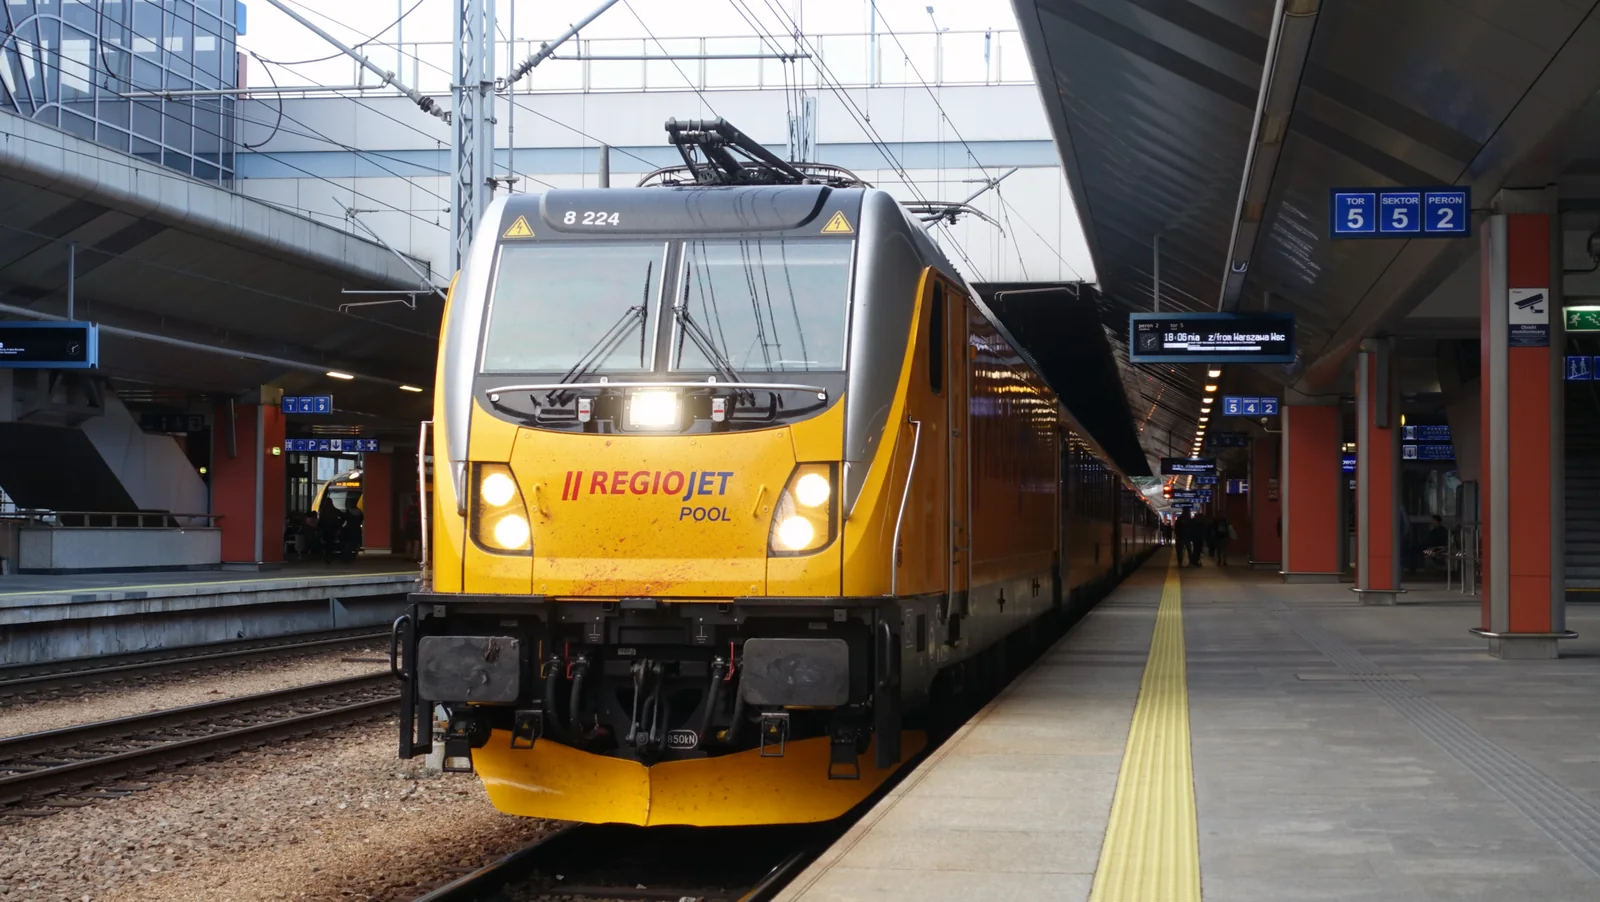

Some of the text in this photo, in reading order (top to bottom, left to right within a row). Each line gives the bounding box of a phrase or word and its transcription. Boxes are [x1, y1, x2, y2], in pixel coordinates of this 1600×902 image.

[1346, 197, 1365, 205] TOR
[1382, 197, 1419, 205] SEKTOR
[1428, 196, 1462, 204] PERON
[563, 211, 620, 226] 8 224
[1347, 208, 1364, 229] 5
[1392, 208, 1409, 229] 5
[1436, 207, 1454, 228] 2
[1233, 332, 1269, 342] Warszawa
[1230, 404, 1237, 413] 5
[1247, 404, 1255, 413] 4
[1265, 404, 1273, 413] 2
[589, 470, 734, 502] REGIOJET
[679, 506, 731, 522] POOL
[667, 734, 695, 744] 850kN
